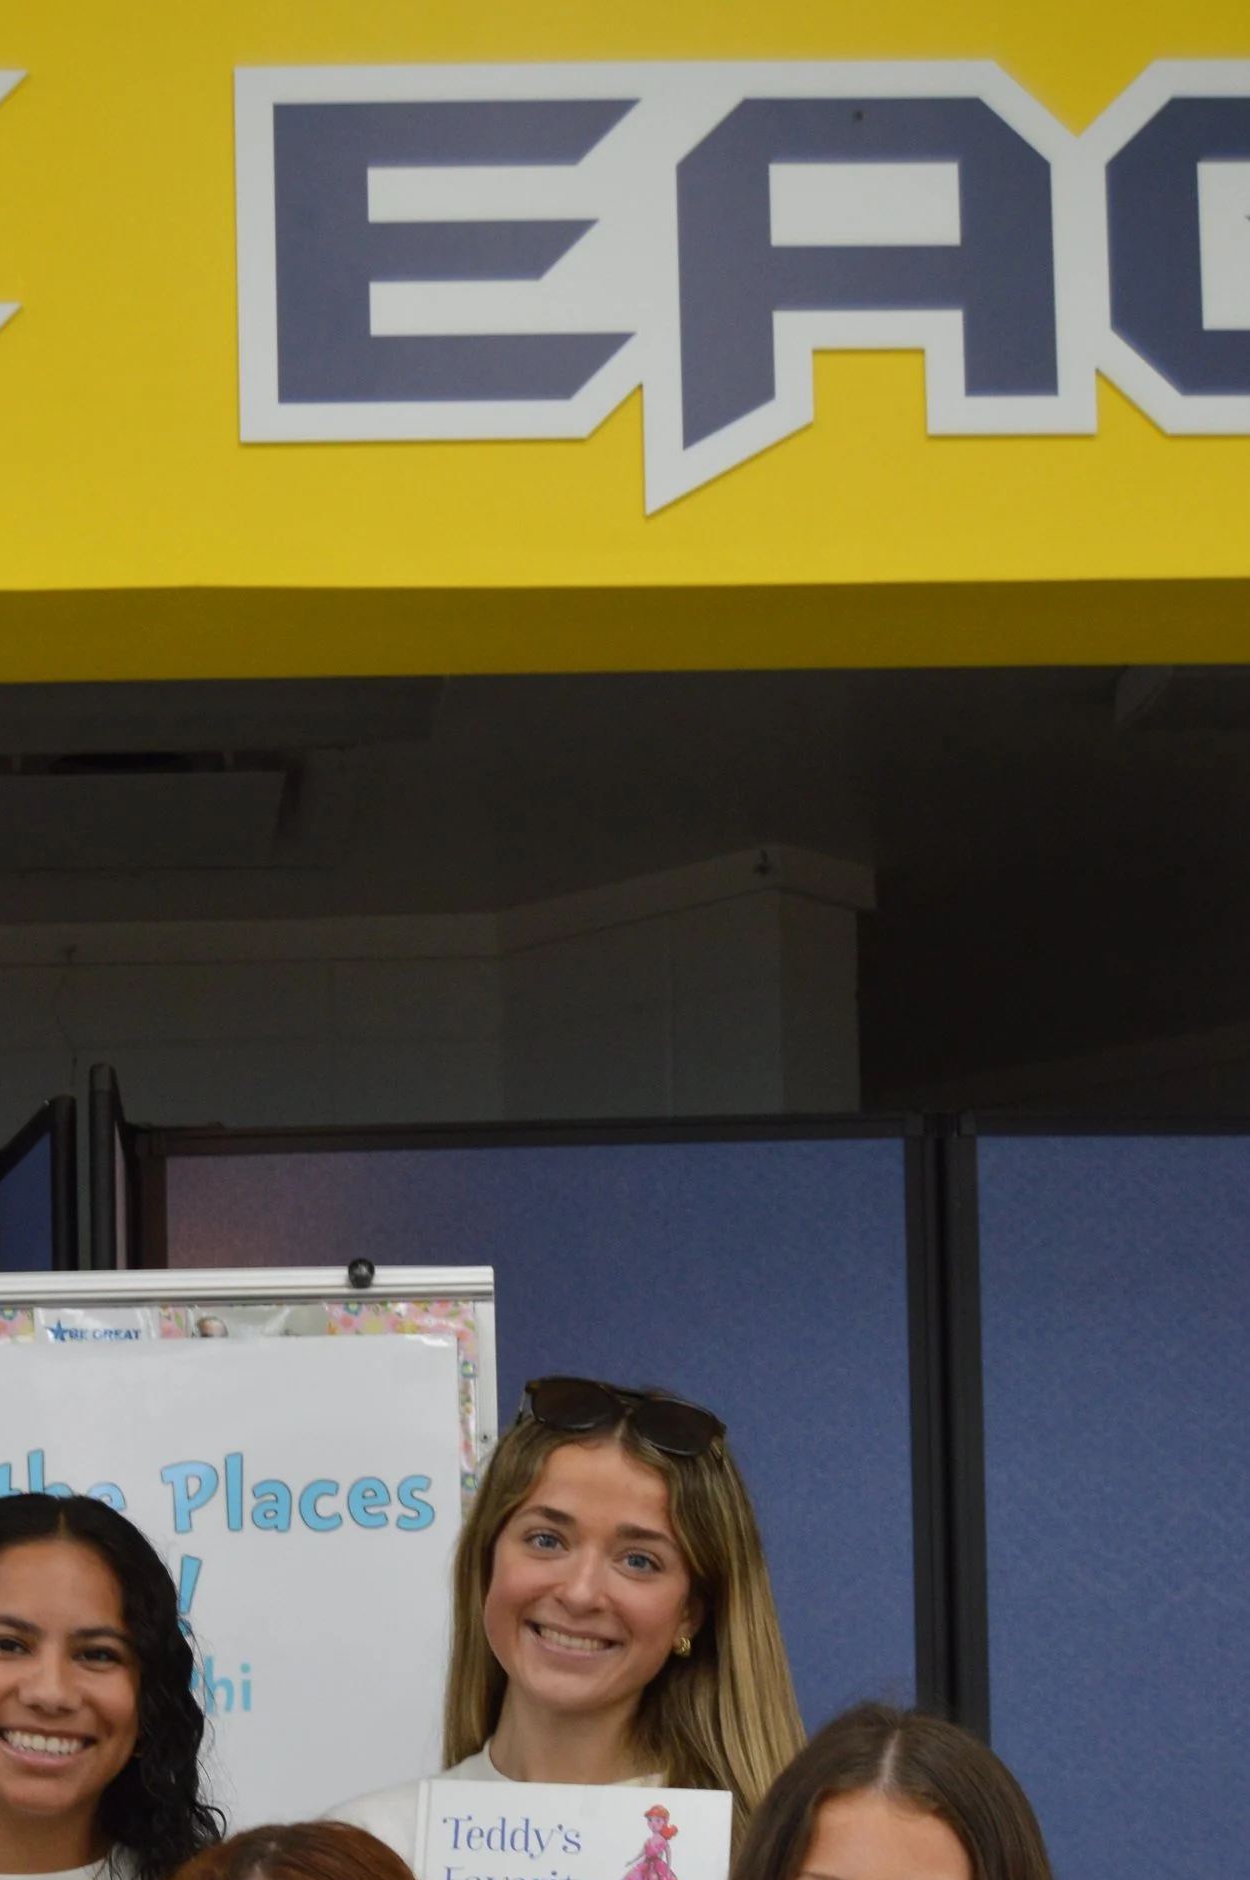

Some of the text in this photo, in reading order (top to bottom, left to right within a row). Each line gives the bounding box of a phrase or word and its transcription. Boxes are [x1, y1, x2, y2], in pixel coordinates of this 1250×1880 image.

[92, 1328, 141, 1340] GREAT
[161, 1454, 435, 1532] Places
[442, 1815, 582, 1859] Teddy's
